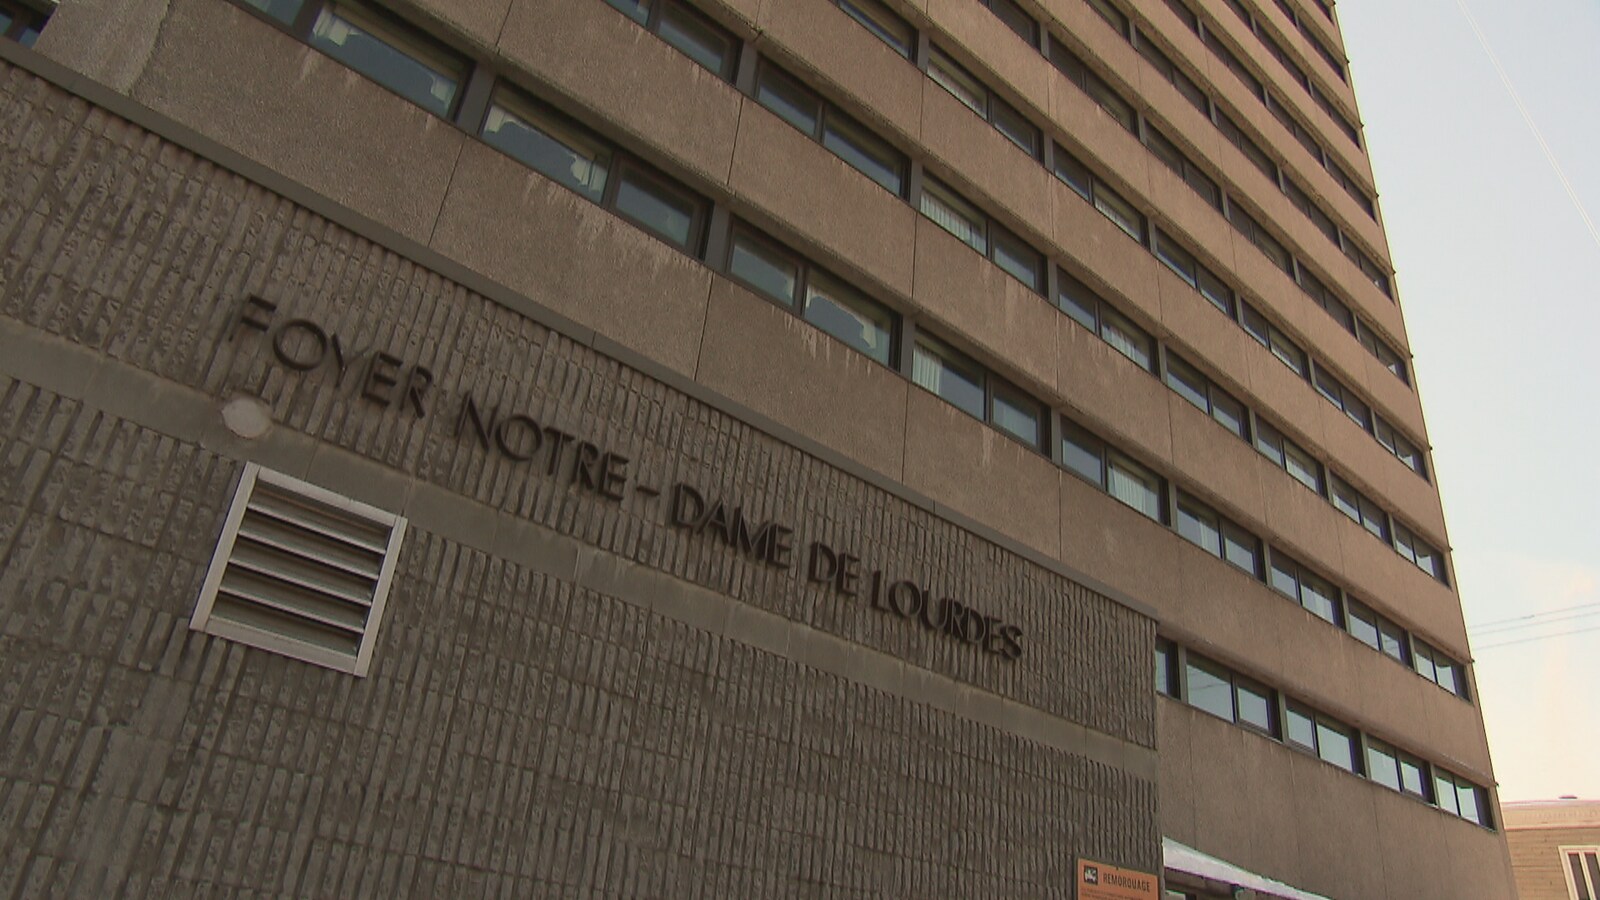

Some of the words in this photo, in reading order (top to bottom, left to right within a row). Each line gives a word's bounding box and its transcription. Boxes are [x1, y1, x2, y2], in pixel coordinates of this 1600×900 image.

[228, 294, 435, 419] FOYER
[807, 541, 861, 598] DE
[870, 570, 1024, 660] LOURDES
[1103, 873, 1151, 893] REMORQUAGE
